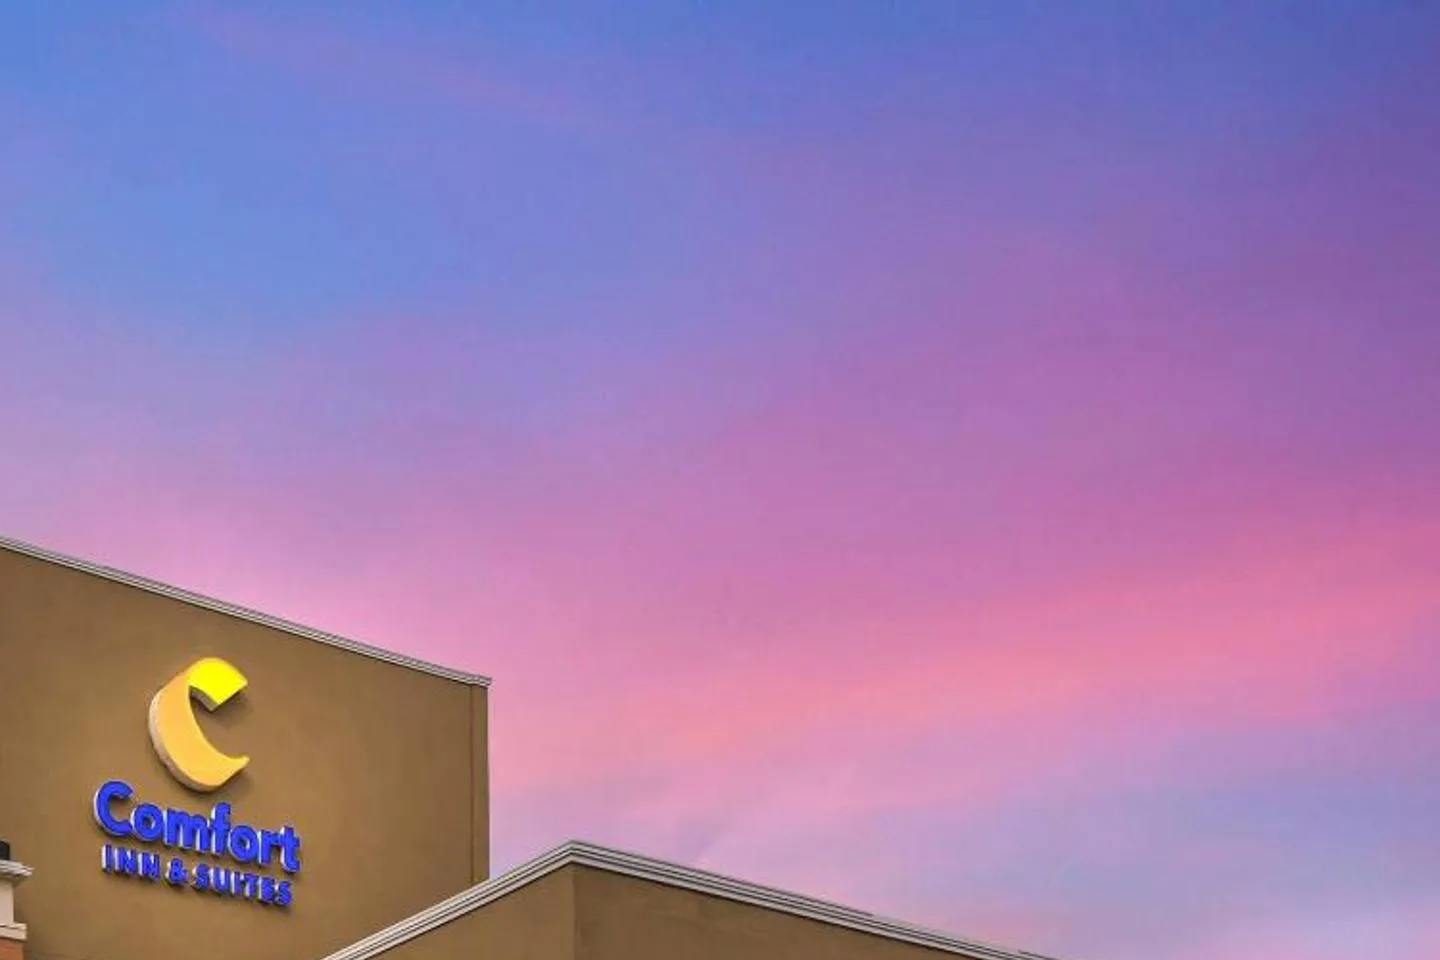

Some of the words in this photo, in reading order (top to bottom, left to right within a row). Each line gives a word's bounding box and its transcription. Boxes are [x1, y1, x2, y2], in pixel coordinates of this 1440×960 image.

[93, 779, 301, 873] Comfort
[101, 844, 160, 881] INN
[165, 857, 189, 886] &
[191, 863, 293, 906] SUITES
